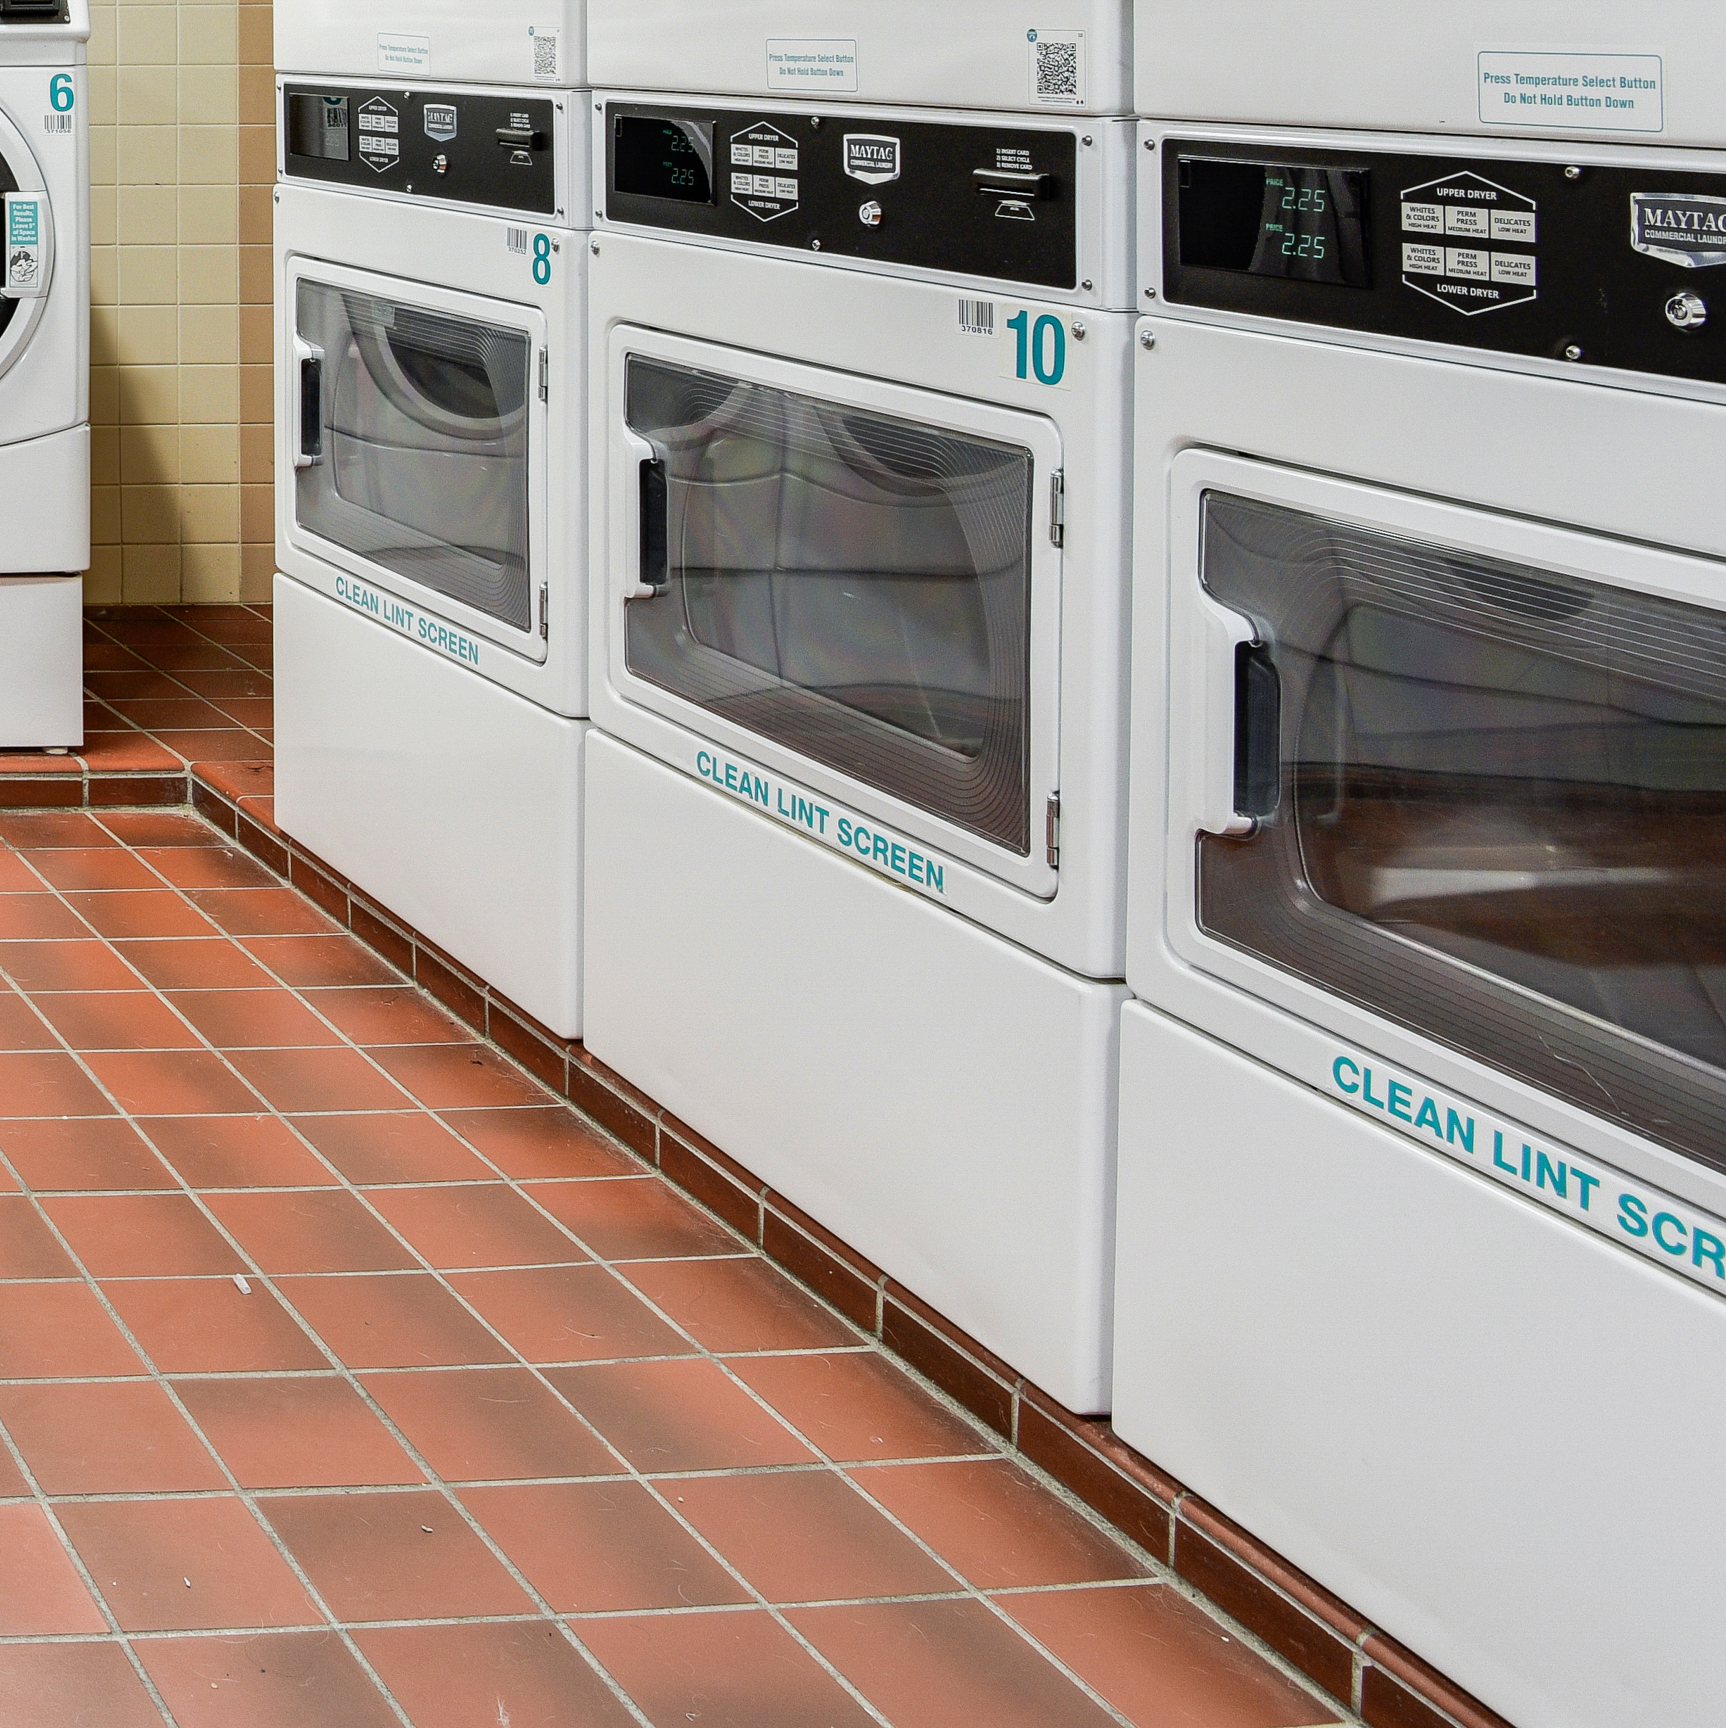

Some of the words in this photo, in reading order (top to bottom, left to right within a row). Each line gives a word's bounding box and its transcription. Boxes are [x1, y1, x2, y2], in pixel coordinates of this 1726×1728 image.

[50, 73, 74, 112] 6
[1484, 72, 1511, 86] Press
[1514, 74, 1578, 89] Temperature
[1581, 76, 1616, 89] Select
[1619, 77, 1656, 90] Button
[1503, 92, 1518, 105] Do
[1520, 92, 1538, 105] Not
[1540, 93, 1563, 106] Hold
[1566, 94, 1602, 108] Button
[1605, 95, 1634, 109] Down
[850, 144, 893, 160] MAYTAG
[1281, 187, 1326, 213] 2.25
[1437, 187, 1465, 199] UPPER
[1467, 189, 1497, 201] DRYER
[1281, 233, 1326, 259] 2.25
[532, 234, 551, 285] 8
[1437, 284, 1465, 297] LOWER
[1468, 287, 1499, 299] DRYER
[960, 325, 994, 337] 370816
[1006, 309, 1066, 387] 10
[336, 576, 379, 612] CLEAN
[382, 602, 415, 633] LINT
[418, 617, 480, 666] SCREEN
[696, 750, 770, 808] CLEAN
[777, 793, 830, 835] LINT
[837, 818, 944, 894] SCREEN
[1332, 1055, 1475, 1154] CLEAN
[1493, 1129, 1600, 1212] LINT
[1616, 1193, 1726, 1280] SCR
